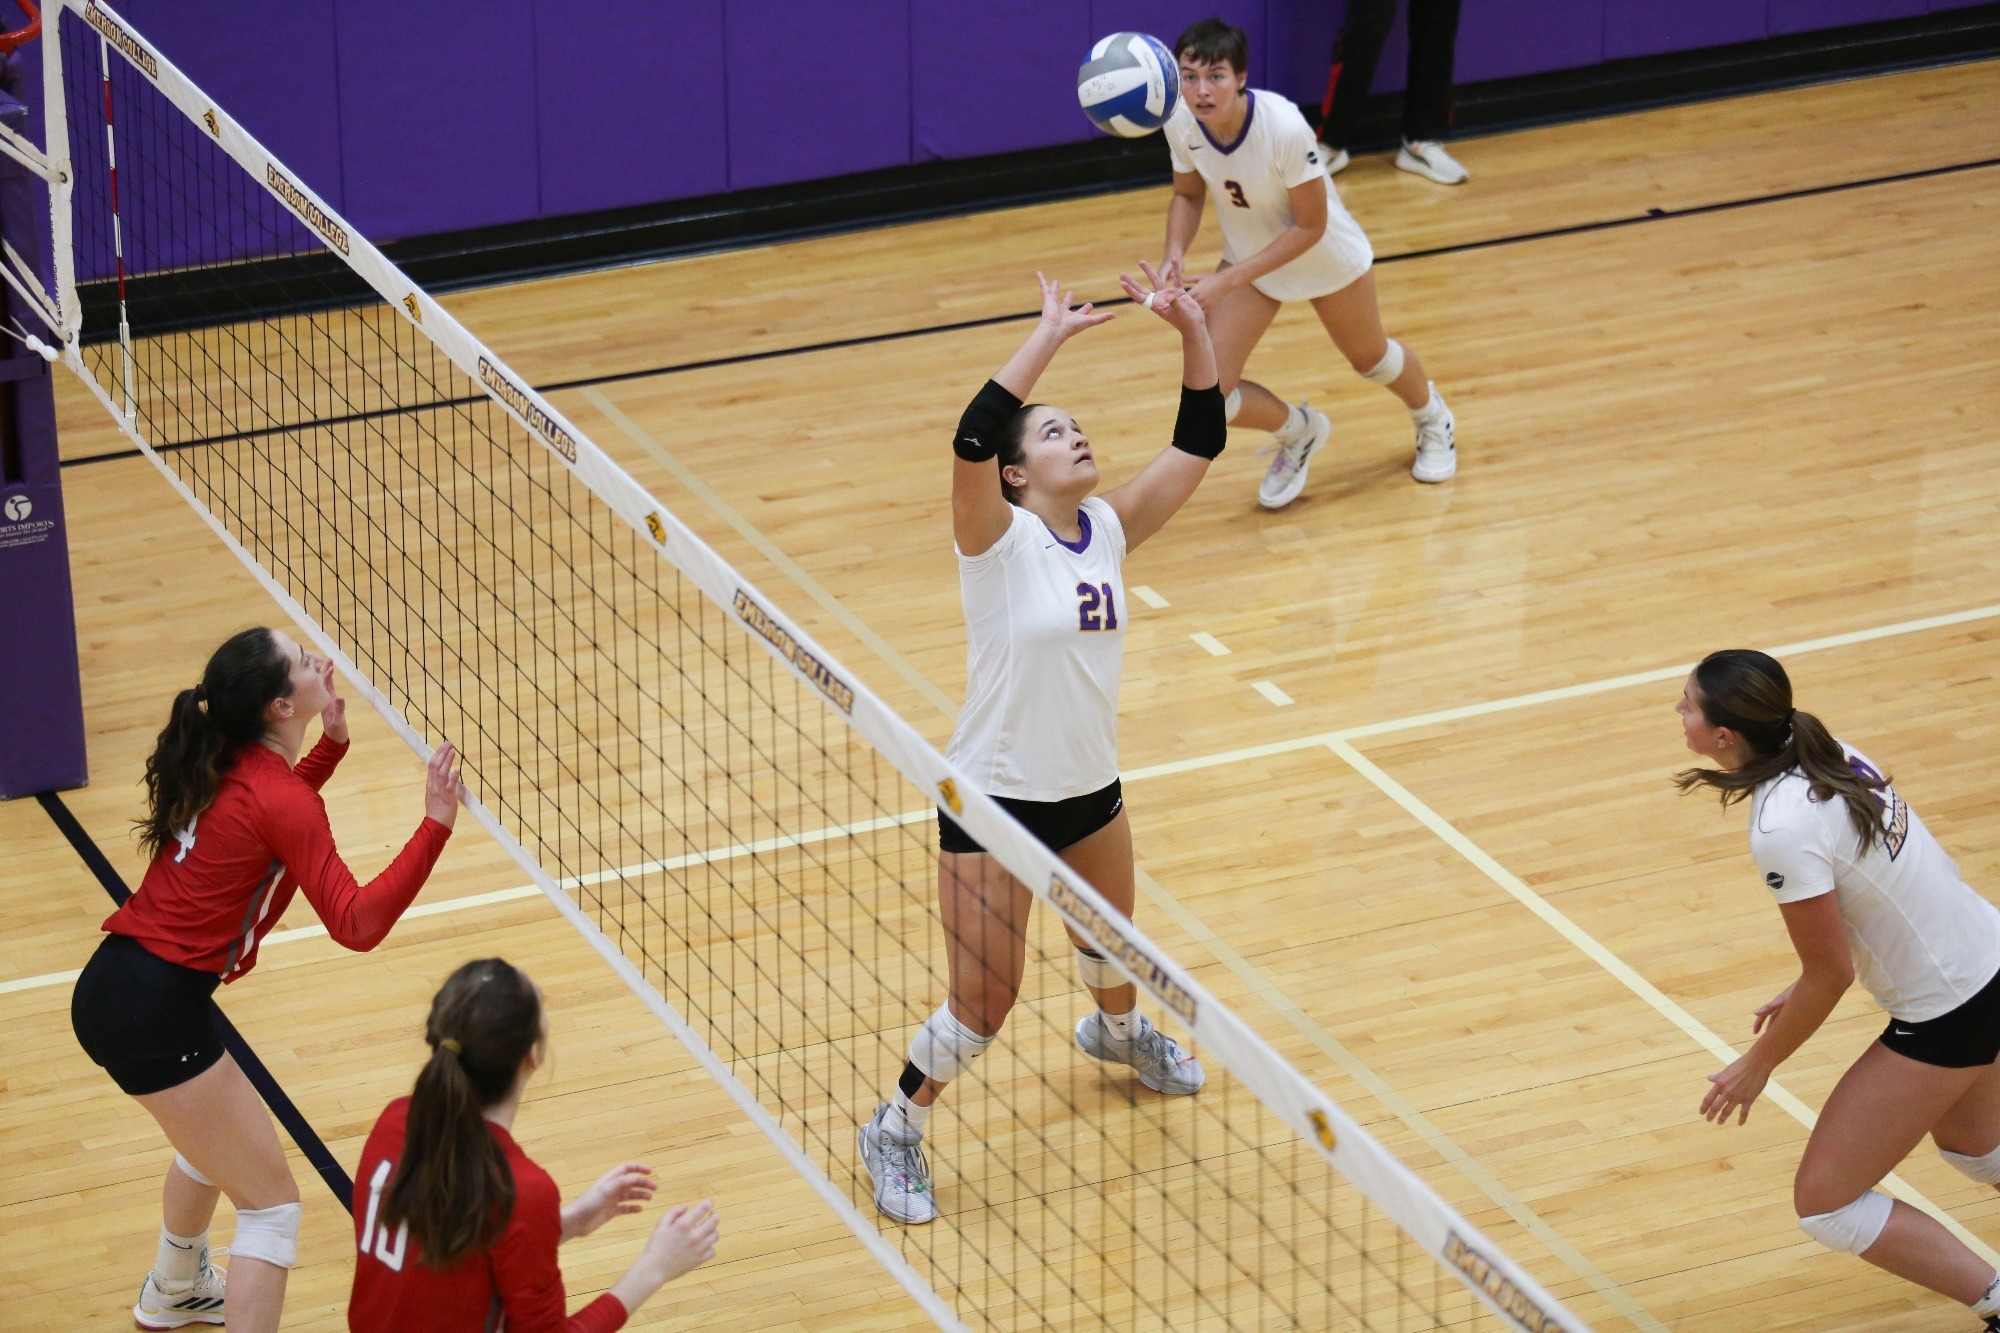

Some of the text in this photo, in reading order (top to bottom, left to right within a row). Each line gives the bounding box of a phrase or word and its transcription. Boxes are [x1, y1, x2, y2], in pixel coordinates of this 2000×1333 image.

[86, 1, 157, 80] EMERSON COLLEGE
[267, 162, 350, 256] EMERSON COLLEGE
[1223, 179, 1251, 209] 3
[478, 355, 577, 465] EMERSON COLLEGE
[1075, 581, 1118, 632] 21
